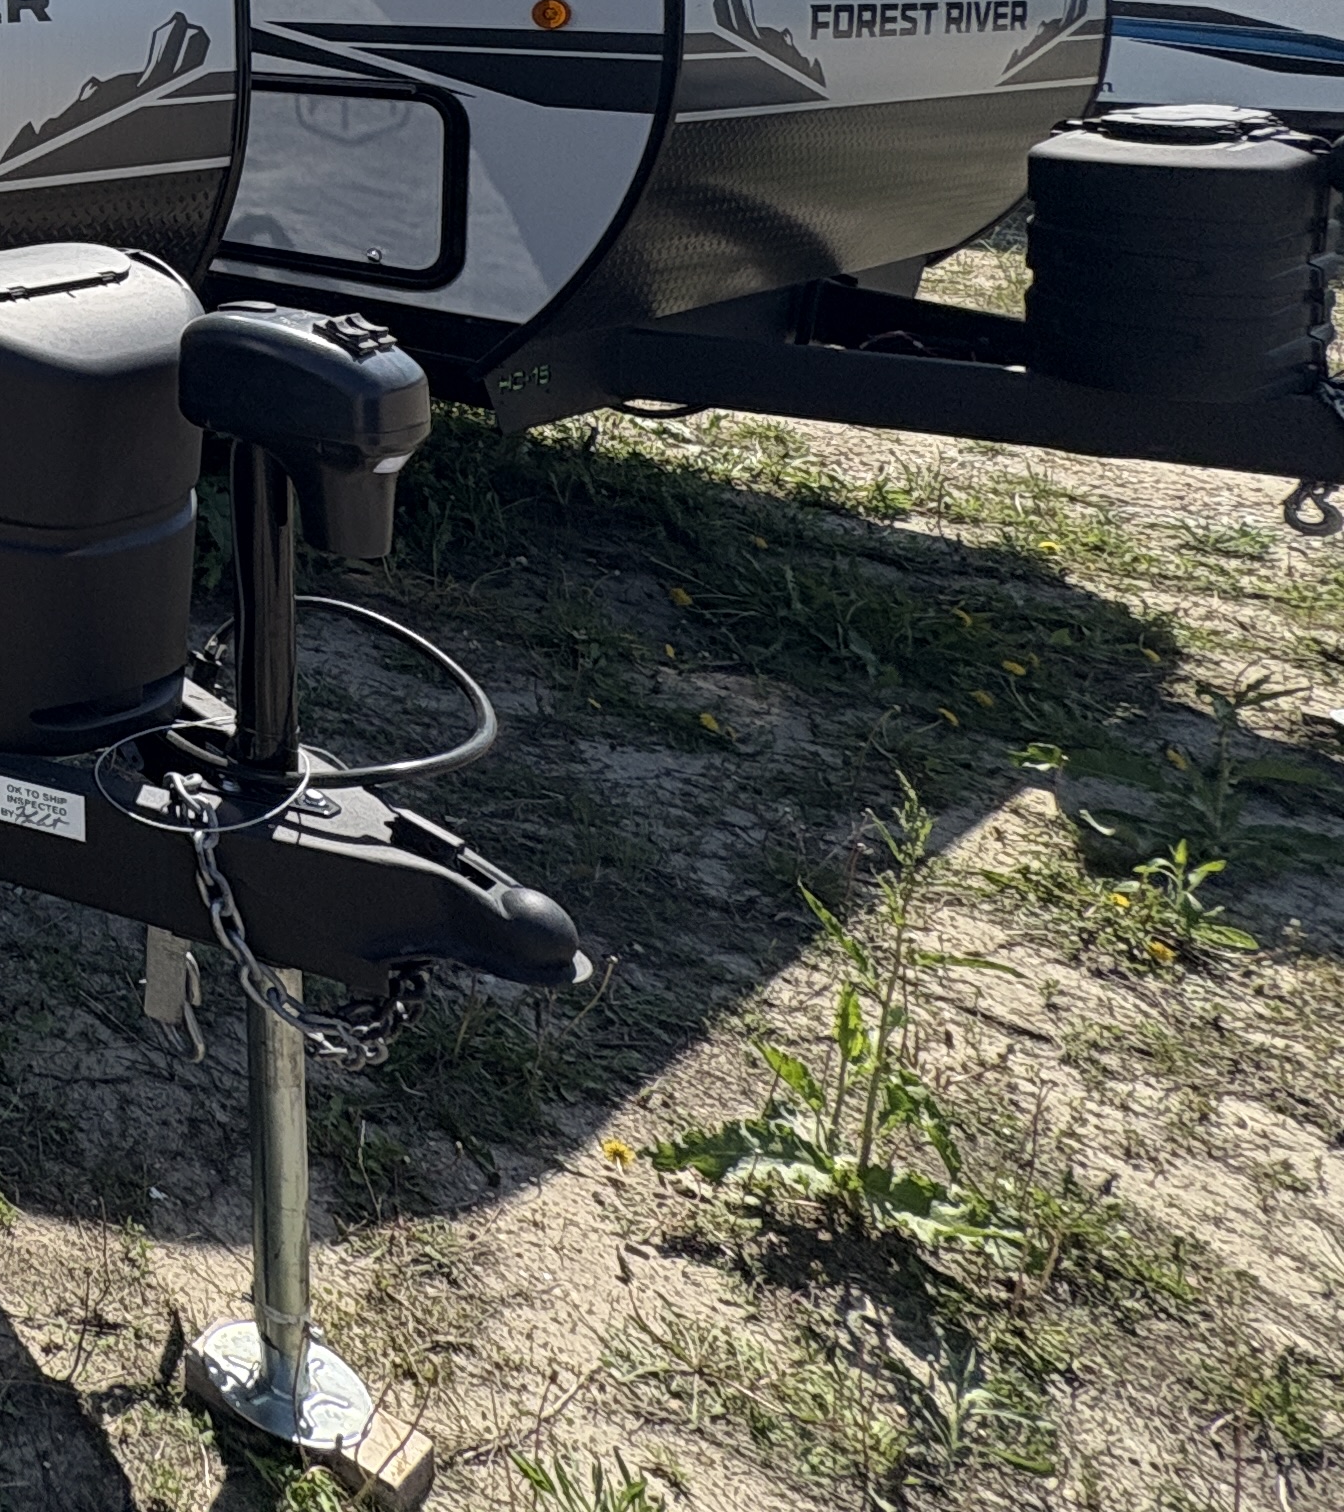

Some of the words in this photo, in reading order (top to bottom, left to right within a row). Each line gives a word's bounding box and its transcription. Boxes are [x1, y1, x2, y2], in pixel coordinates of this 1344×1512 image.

[809, 1, 939, 40] FOREST
[945, 0, 1028, 34] RIVER
[6, 784, 23, 795] OK
[24, 788, 40, 799] TO
[42, 792, 68, 805] SHIP
[6, 794, 68, 817] INSPECTED
[0, 807, 15, 818] BY
